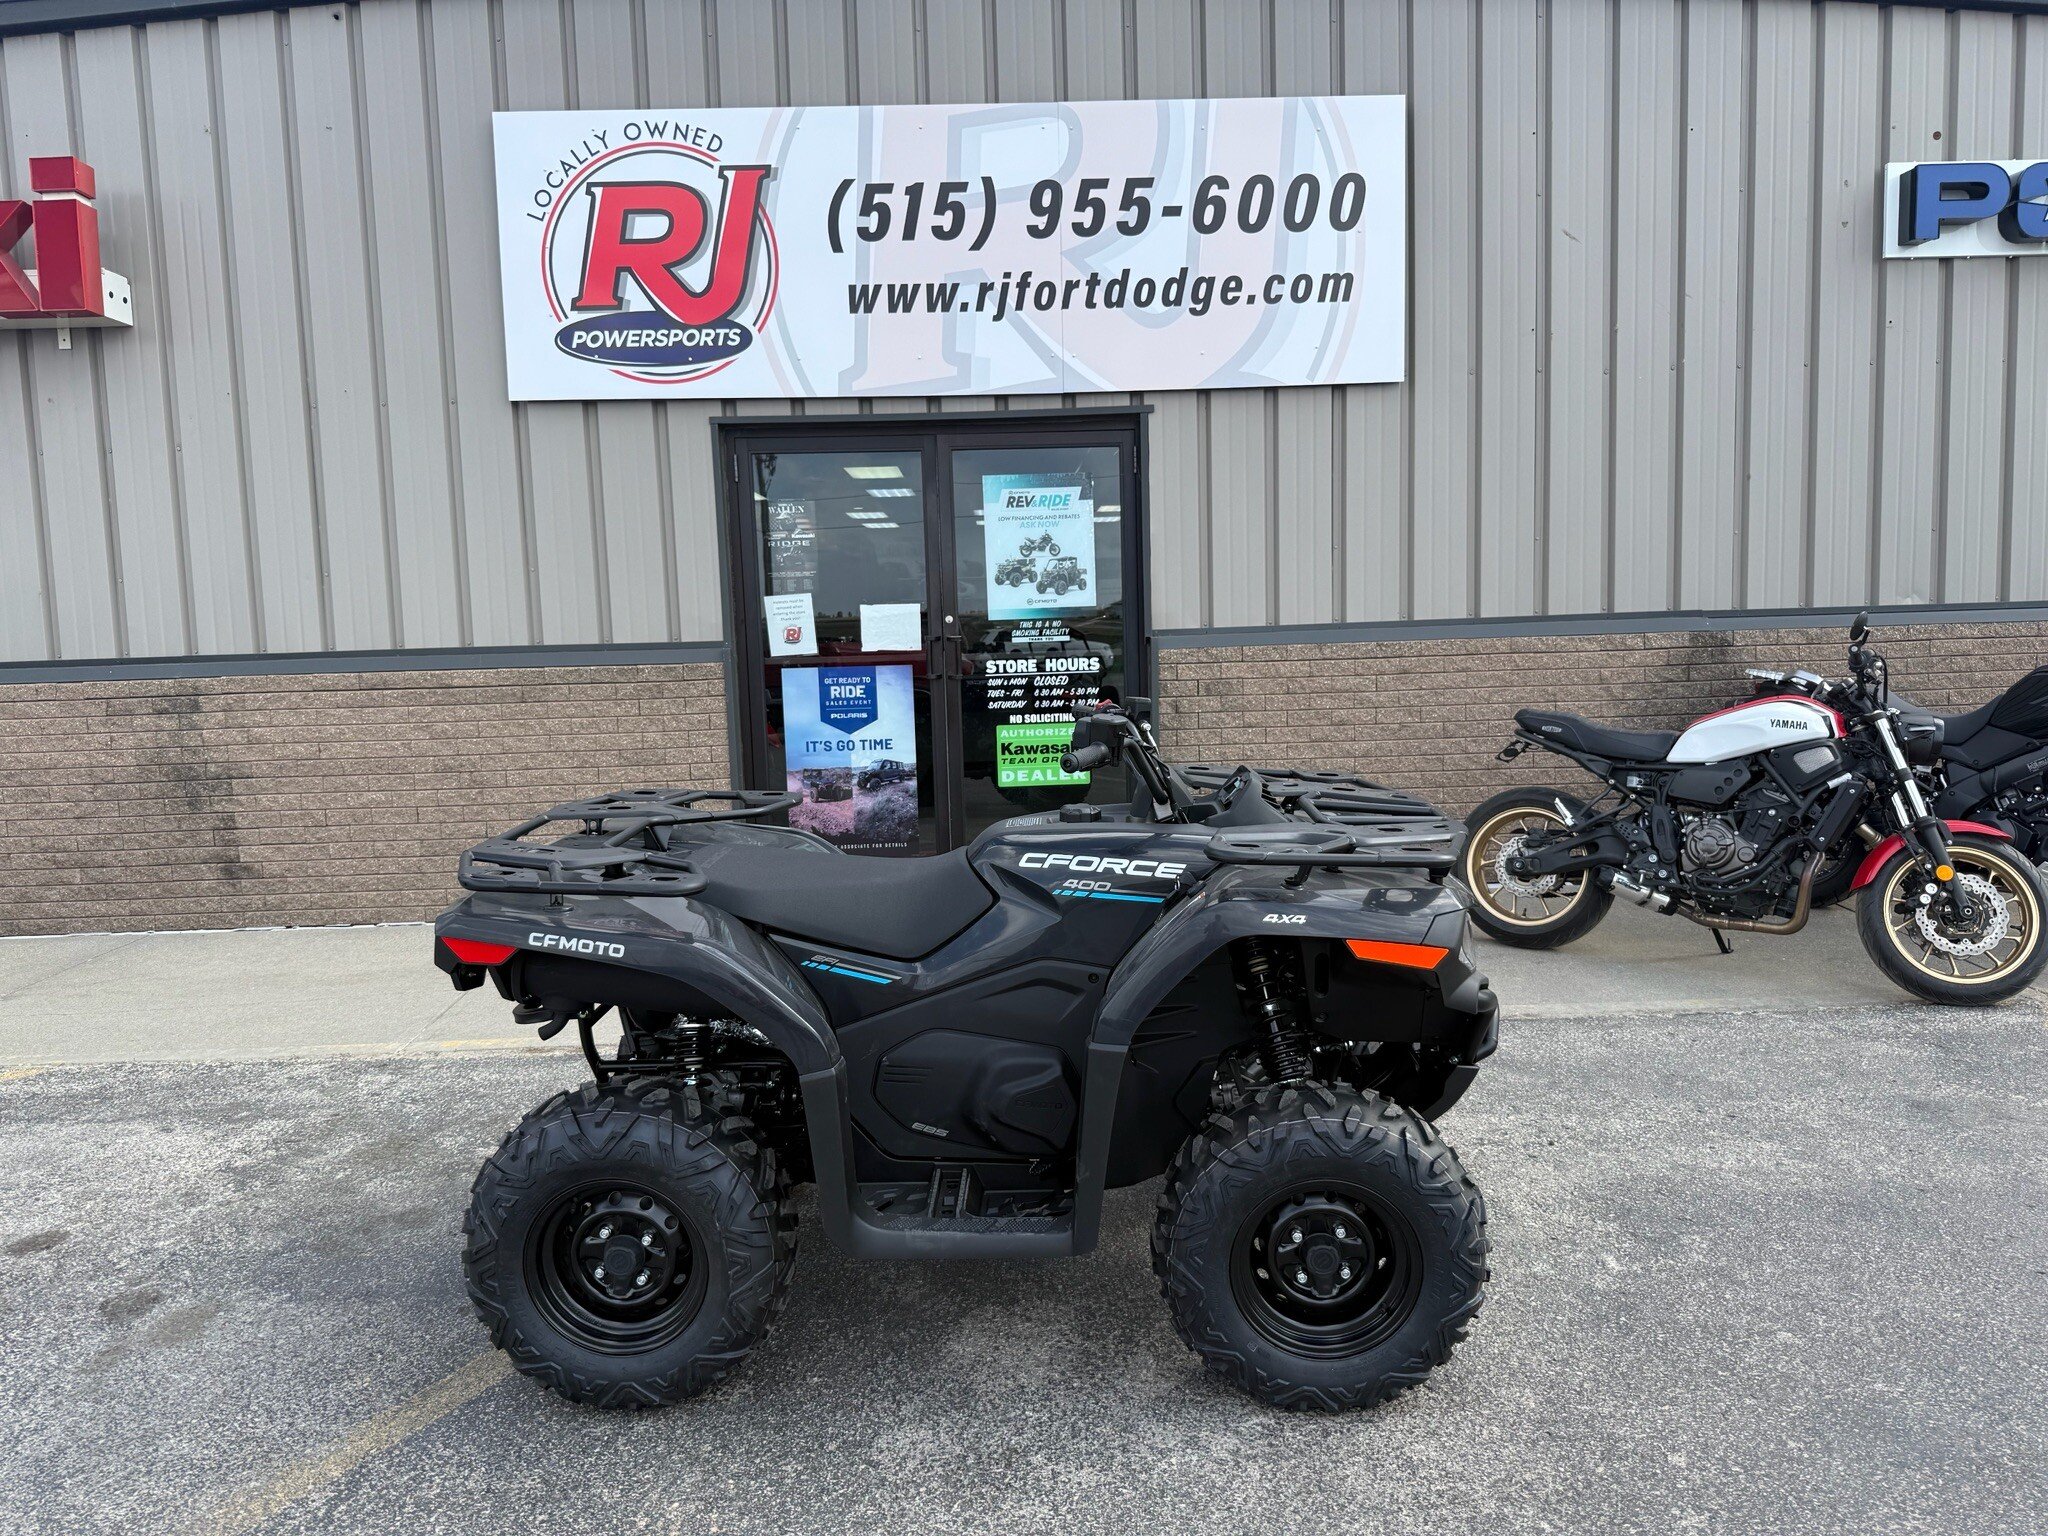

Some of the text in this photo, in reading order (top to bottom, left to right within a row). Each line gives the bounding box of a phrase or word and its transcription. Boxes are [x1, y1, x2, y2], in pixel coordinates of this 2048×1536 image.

[527, 119, 724, 222] LOCALLY OWNED
[827, 172, 1367, 253] (515) 955-6000
[571, 163, 776, 326] RJ
[847, 266, 1355, 322] www.rjfortdodge.com
[571, 327, 742, 349] POWERSPORTS
[1020, 520, 1060, 529] ASK NOW
[1012, 629, 1040, 637] SMOKING
[985, 657, 1100, 674] STORE HOURS
[987, 678, 1003, 686] SUN
[1009, 677, 1028, 686] MON
[1034, 676, 1069, 686] CLOSED
[830, 685, 866, 699] RIDE
[987, 689, 1005, 697] TUES
[1011, 688, 1025, 697] FRI
[1050, 688, 1064, 696] AM
[1086, 687, 1099, 695] PM
[988, 700, 1027, 709] SATURDAY
[1050, 699, 1065, 707] AM
[1009, 714, 1023, 724] NO
[1770, 718, 1808, 730] YAMAHA
[1001, 727, 1075, 738] AUTHORIZE
[806, 738, 893, 752] IT'S GO TIME
[1001, 741, 1074, 756] Kawasa
[1002, 757, 1037, 765] TEAM
[1018, 852, 1188, 879] CFORCE
[1062, 879, 1112, 892] 400
[528, 932, 625, 958] CFMOTO
